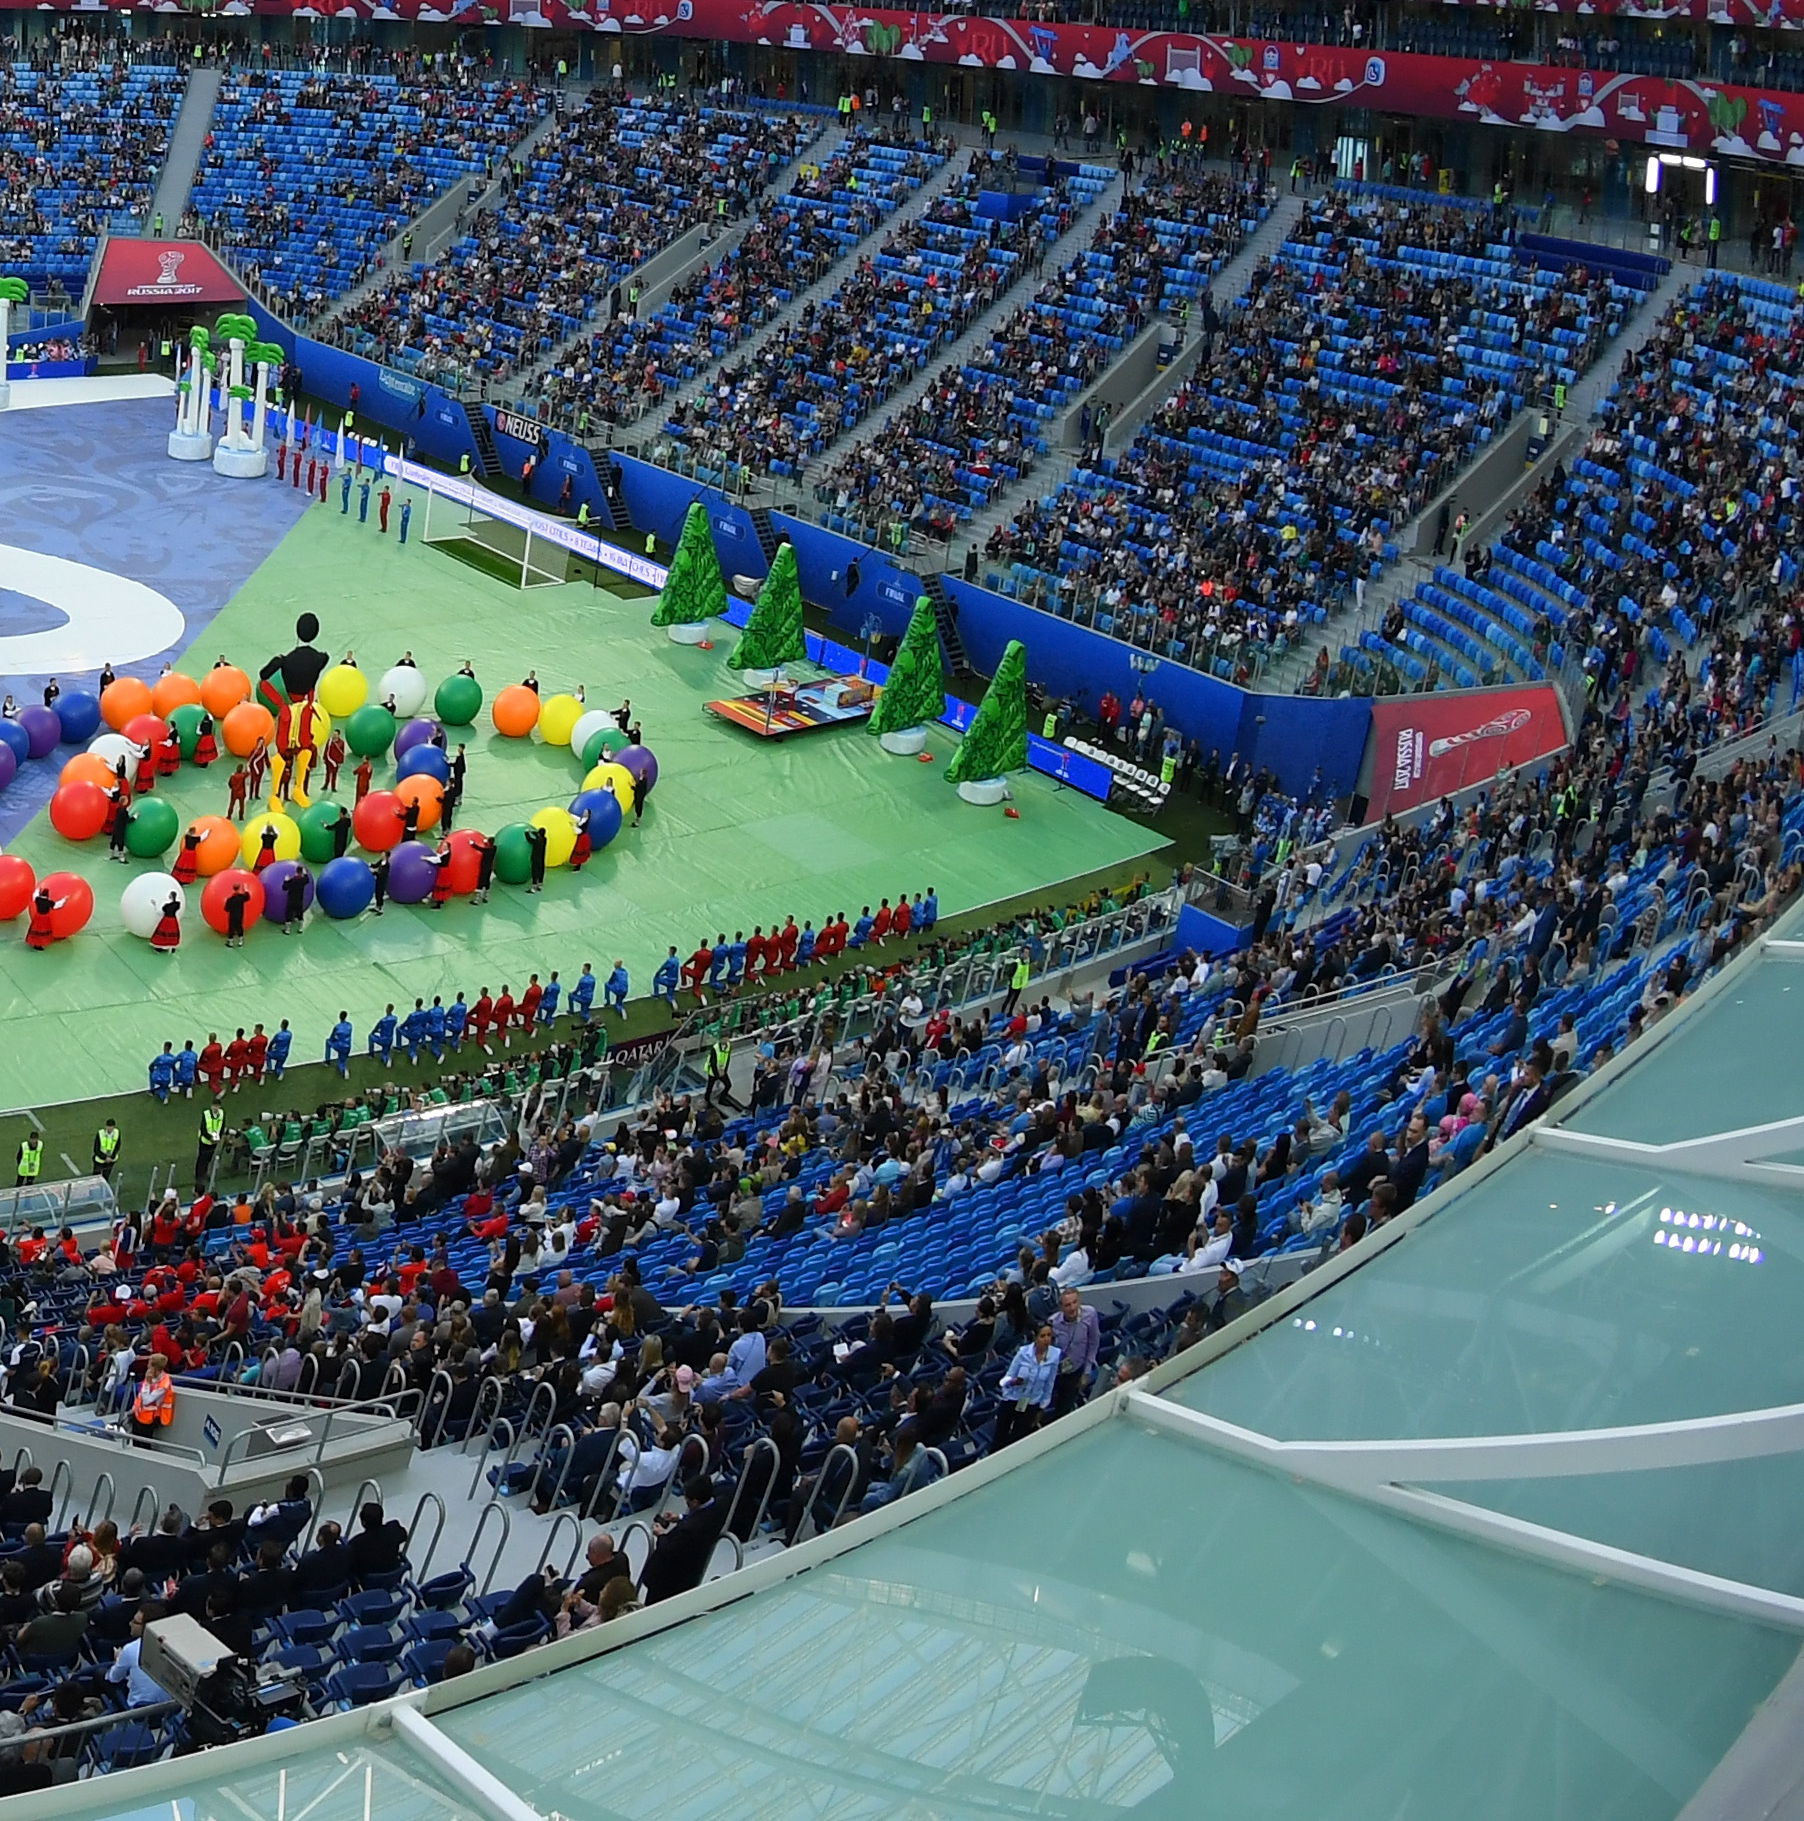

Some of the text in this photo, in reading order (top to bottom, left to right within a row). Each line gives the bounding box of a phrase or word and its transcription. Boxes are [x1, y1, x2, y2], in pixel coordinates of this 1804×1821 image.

[126, 287, 173, 296] RUSSIA
[504, 414, 542, 445] NEUSS
[1396, 728, 1414, 767] RUSSIA
